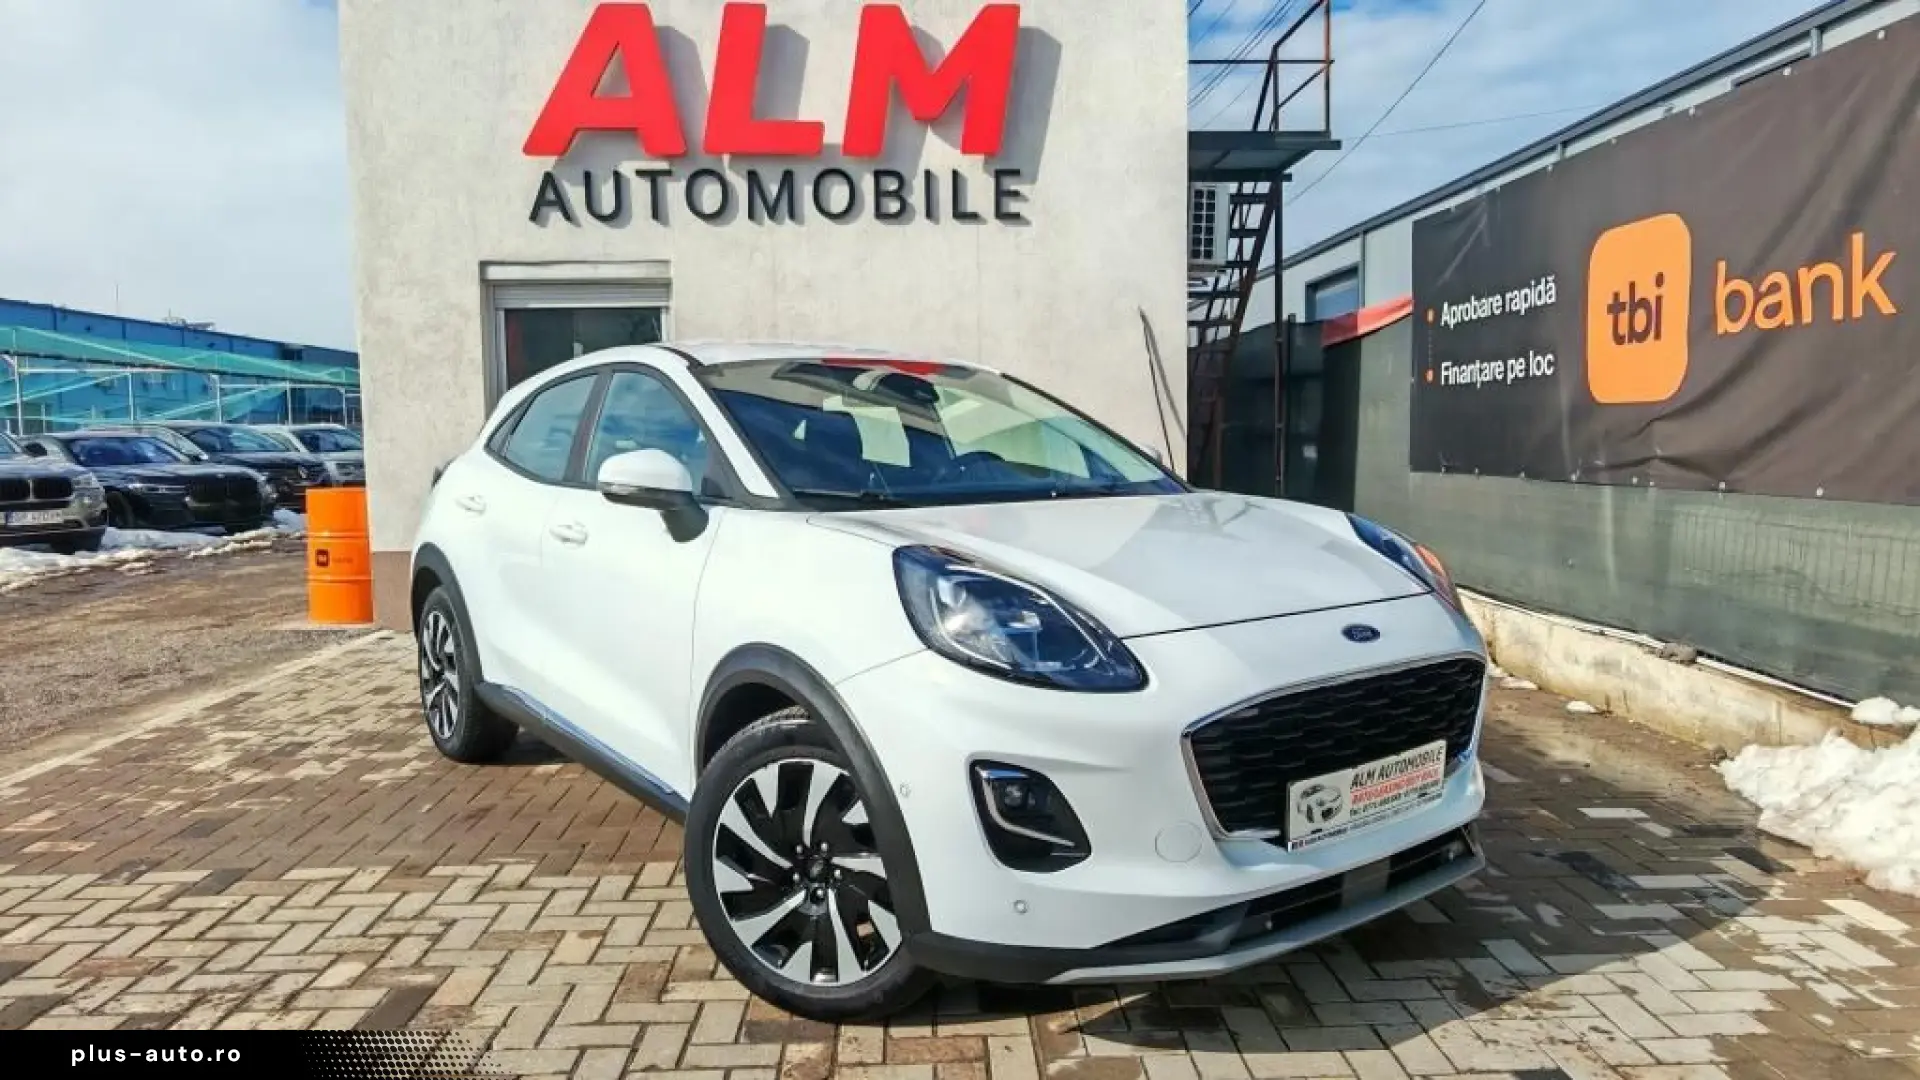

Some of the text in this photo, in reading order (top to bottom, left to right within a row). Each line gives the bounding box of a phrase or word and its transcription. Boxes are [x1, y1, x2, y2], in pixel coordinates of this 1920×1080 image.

[522, 2, 1021, 157] ALM
[528, 168, 1022, 223] AUTOMOBILE
[1440, 274, 1557, 329] Aprobare rapidă
[1606, 231, 1898, 346] tbi bank
[1507, 357, 1526, 385] pe
[1529, 350, 1555, 377] loc
[1351, 770, 1376, 789] ALM
[1378, 746, 1443, 779] AUTOMOBILE
